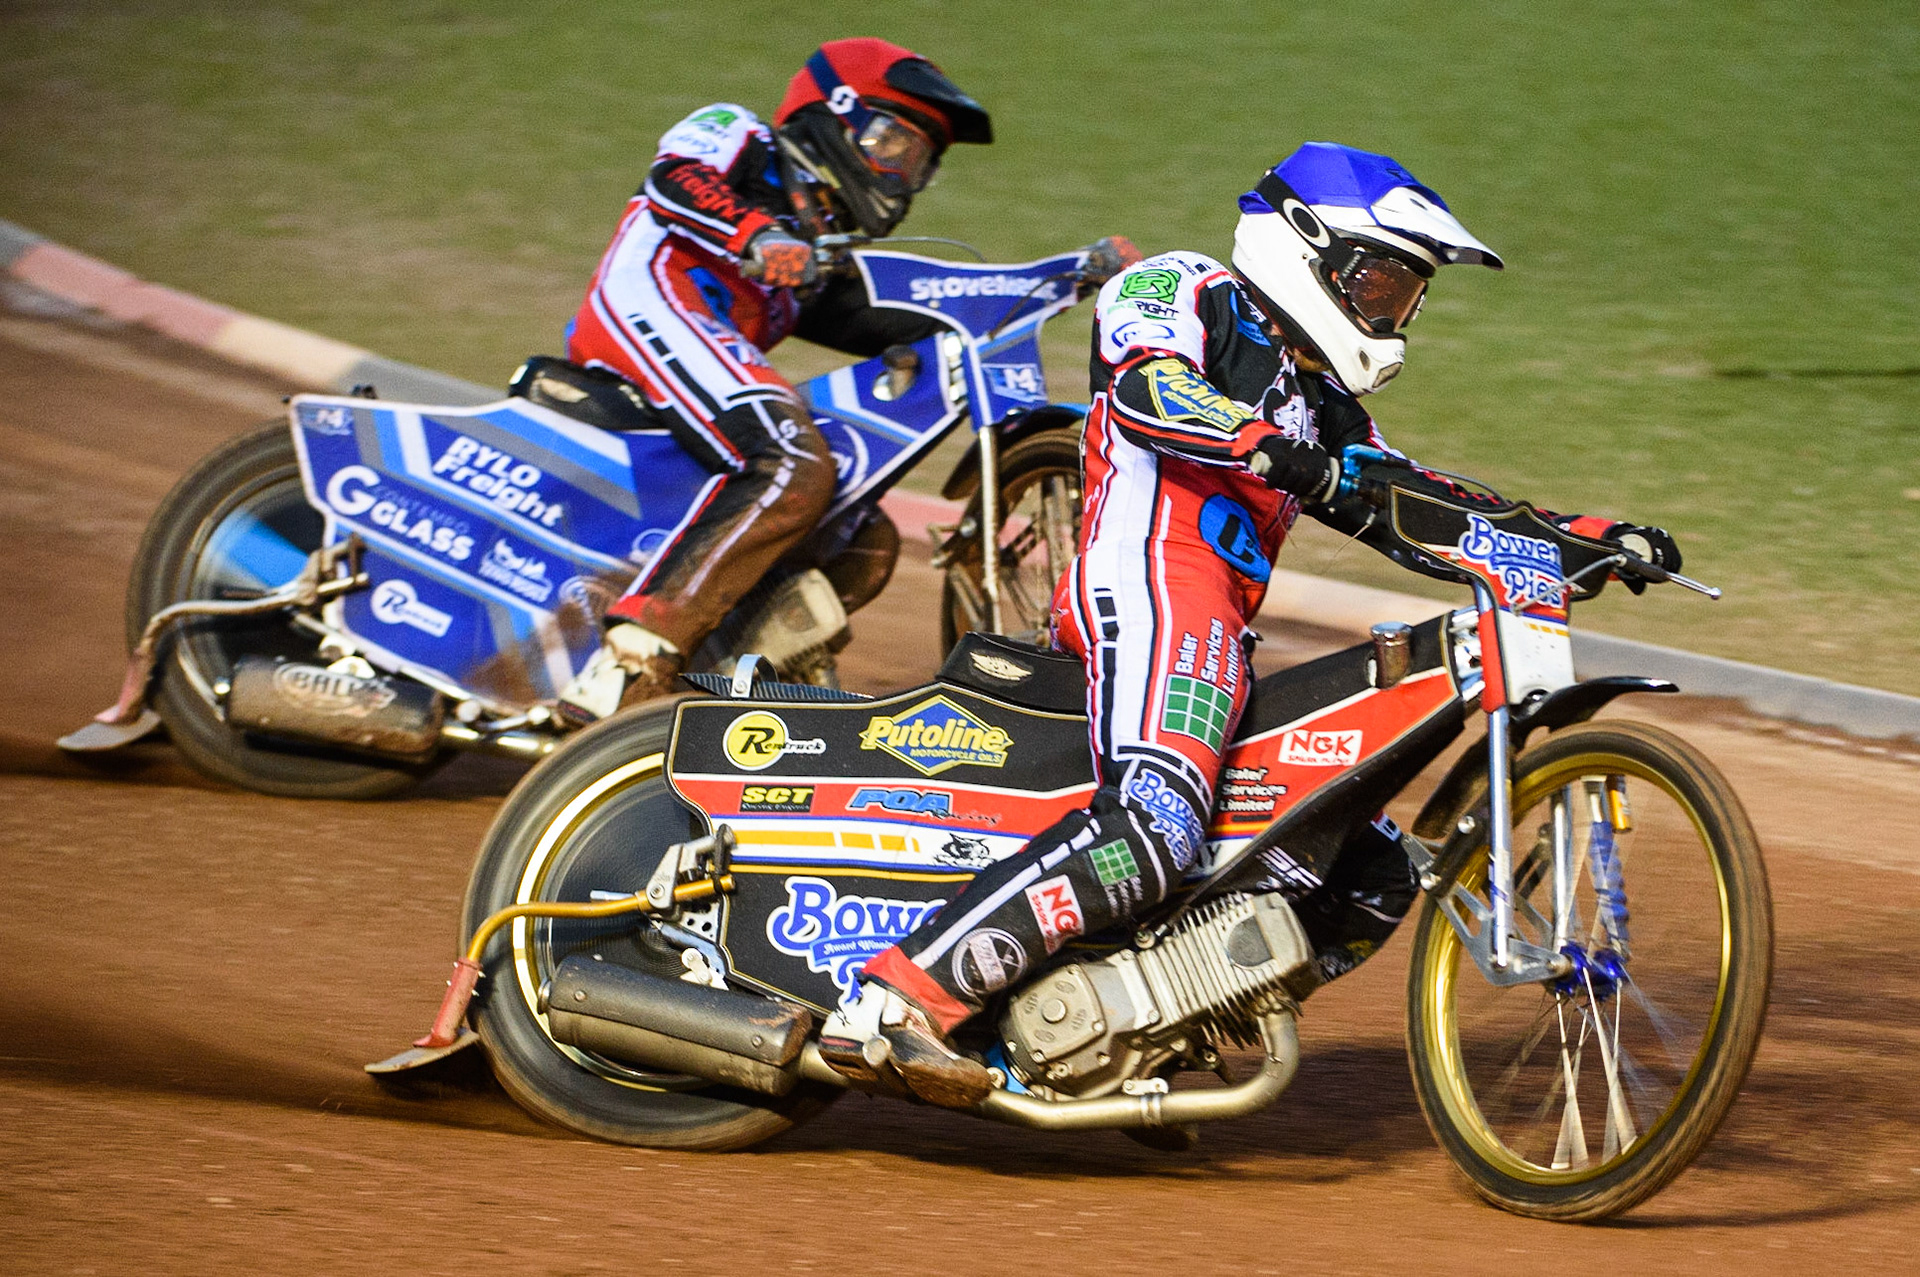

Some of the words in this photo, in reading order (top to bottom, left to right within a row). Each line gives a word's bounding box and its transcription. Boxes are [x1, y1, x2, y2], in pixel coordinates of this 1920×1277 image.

[446, 435, 541, 488] RYLO
[432, 453, 563, 527] Freight
[370, 500, 475, 560] GLASS
[1174, 631, 1199, 674] Baler
[1200, 617, 1224, 684] Services
[1221, 634, 1239, 695] Limited
[862, 718, 1006, 752] Putoline
[1290, 731, 1354, 756] NGK
[850, 789, 950, 813] POA
[1042, 885, 1082, 936] NG
